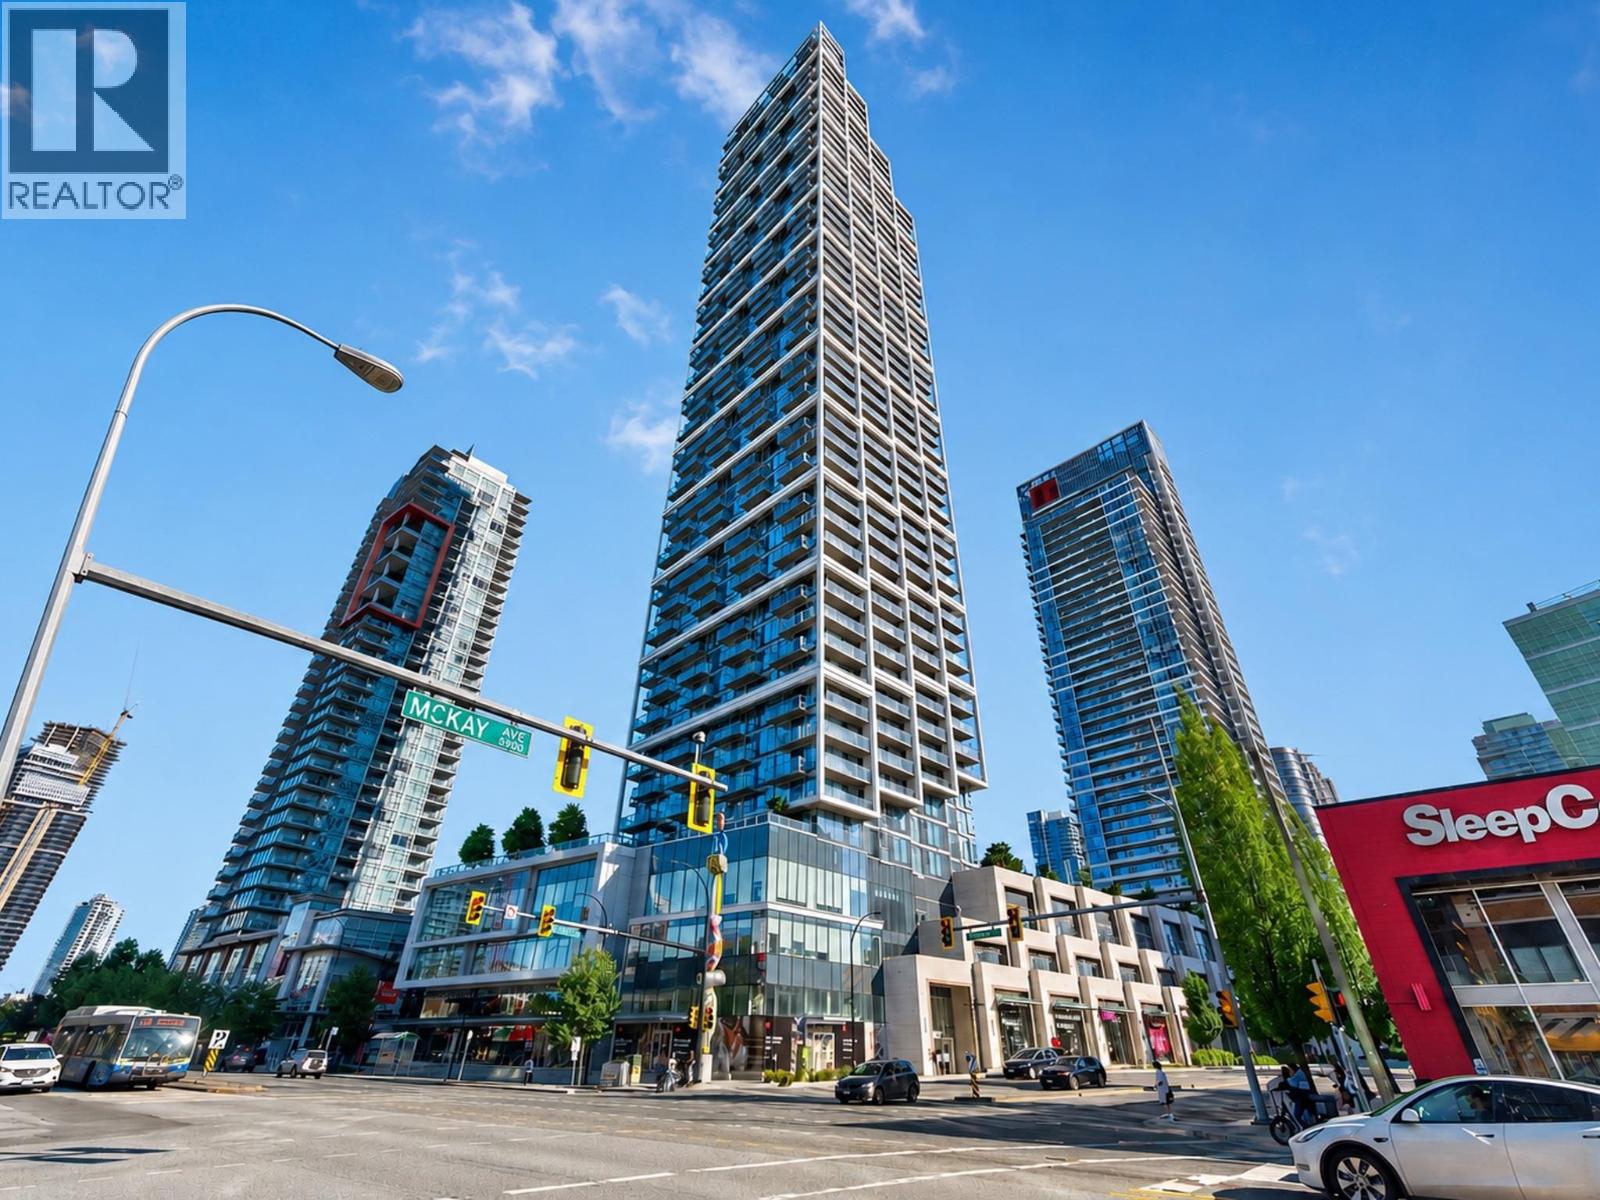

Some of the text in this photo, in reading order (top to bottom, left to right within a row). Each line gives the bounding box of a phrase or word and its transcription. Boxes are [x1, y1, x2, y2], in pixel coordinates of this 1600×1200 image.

[408, 696, 525, 744] MCKAY AVE
[1402, 783, 1600, 847] SleepC
